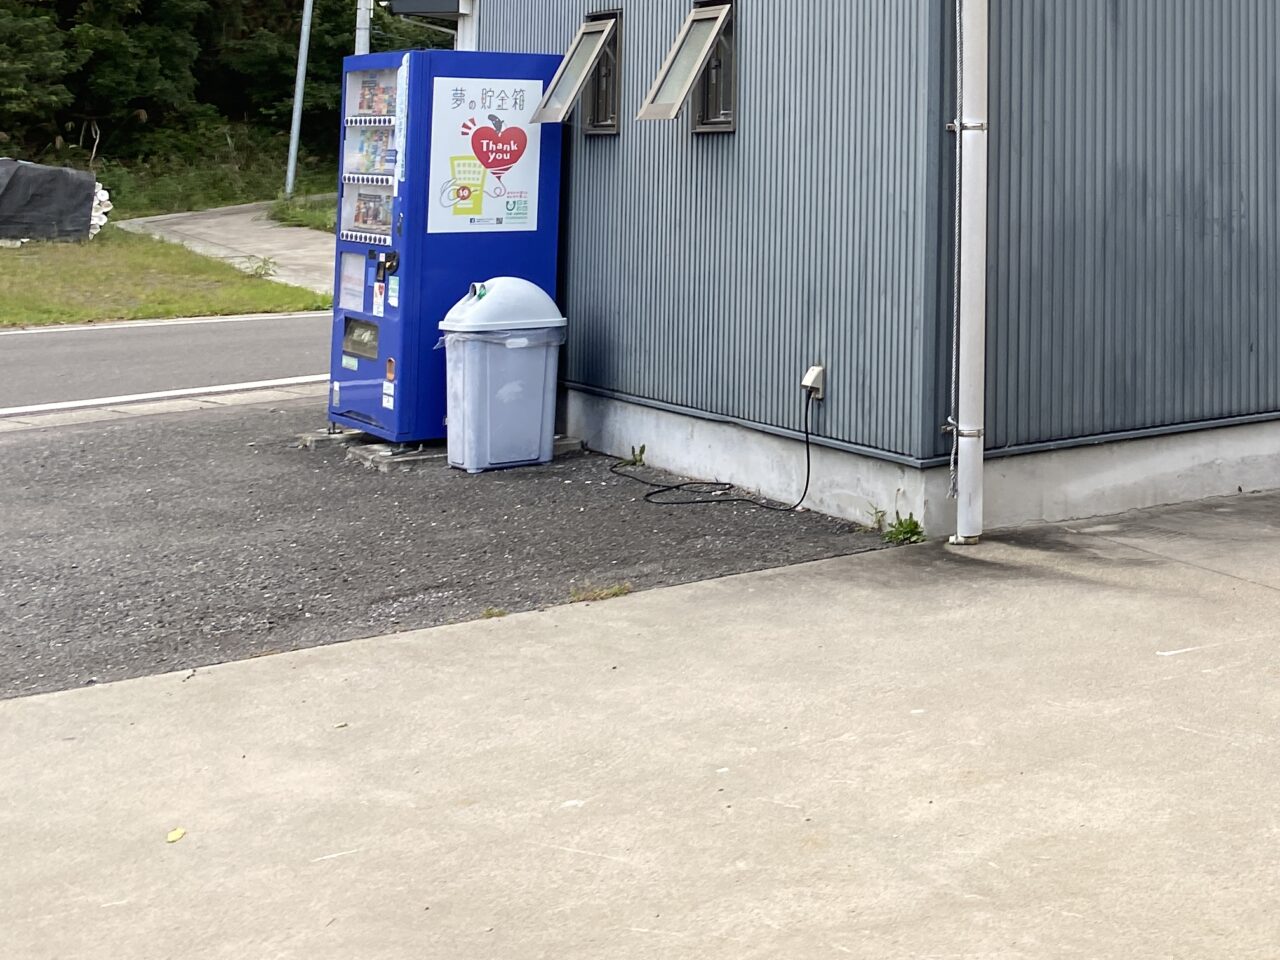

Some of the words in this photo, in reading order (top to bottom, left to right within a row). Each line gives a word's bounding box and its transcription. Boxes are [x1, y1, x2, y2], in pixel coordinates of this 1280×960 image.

[450, 87, 526, 111] 夢の貯金箱
[480, 139, 518, 152] Thank
[488, 151, 511, 163] you
